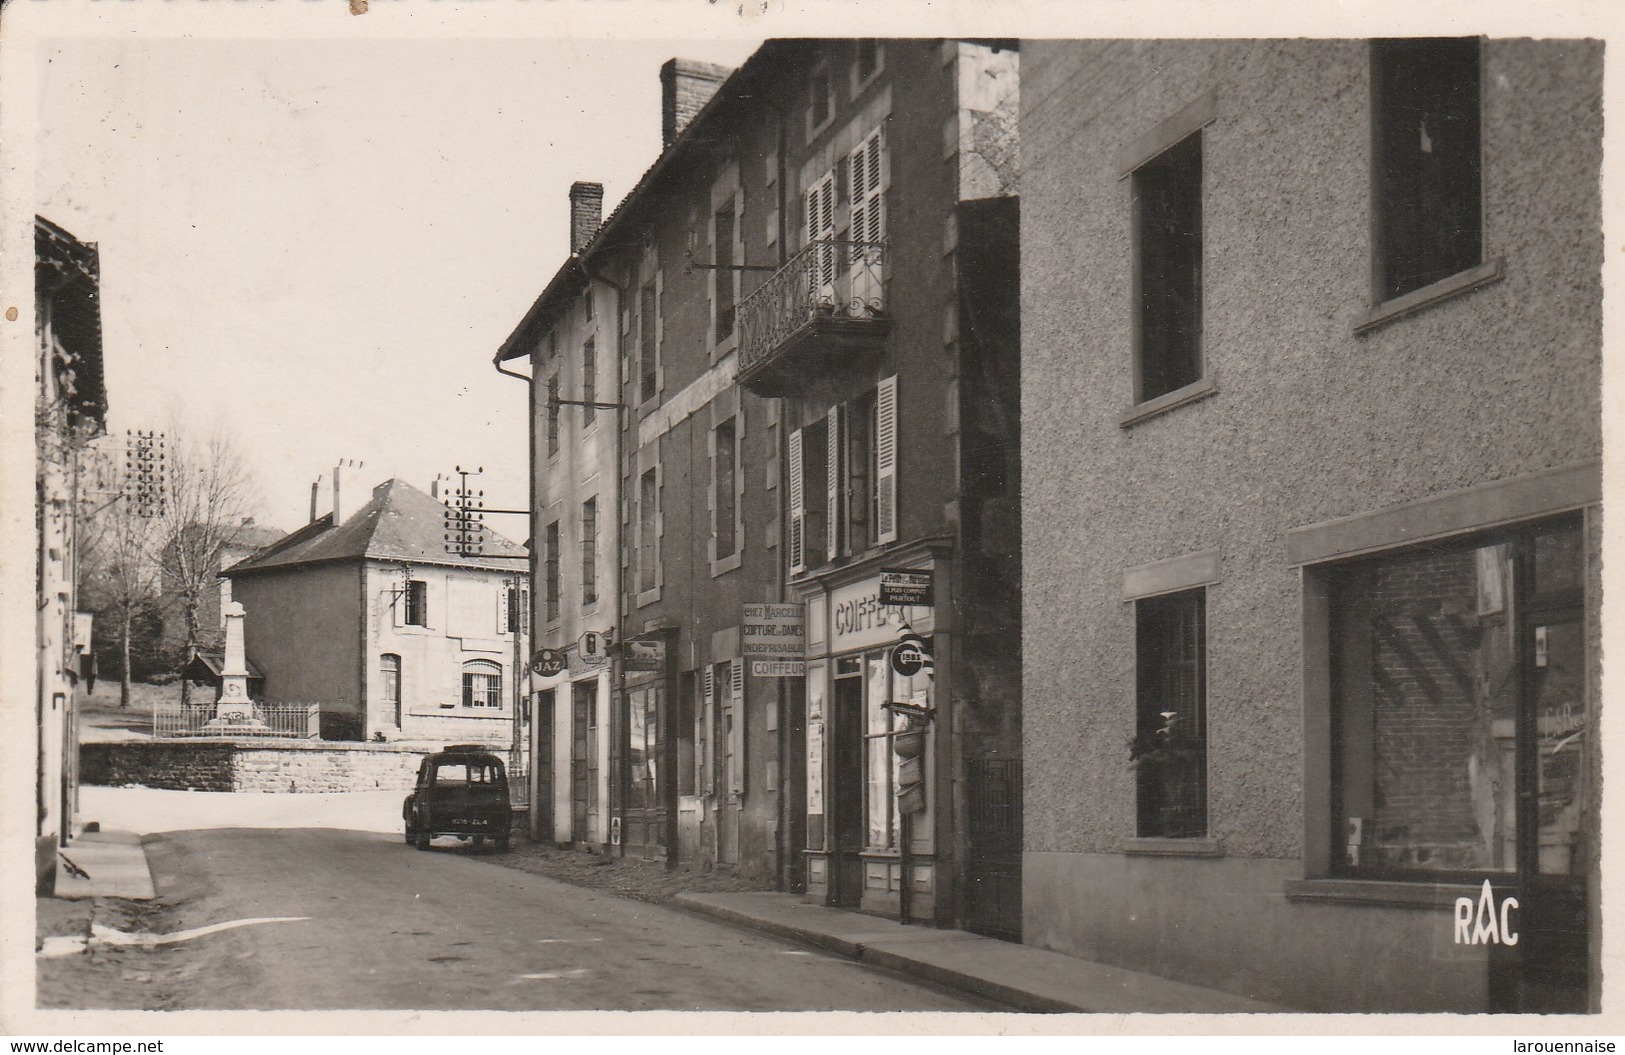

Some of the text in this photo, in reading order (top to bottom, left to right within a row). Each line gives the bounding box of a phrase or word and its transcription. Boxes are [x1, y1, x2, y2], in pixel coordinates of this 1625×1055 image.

[889, 594, 920, 602] PARTOUT
[836, 594, 905, 635] COIFFE
[534, 660, 561, 672] JAZ
[754, 662, 806, 674] COIFFEUR
